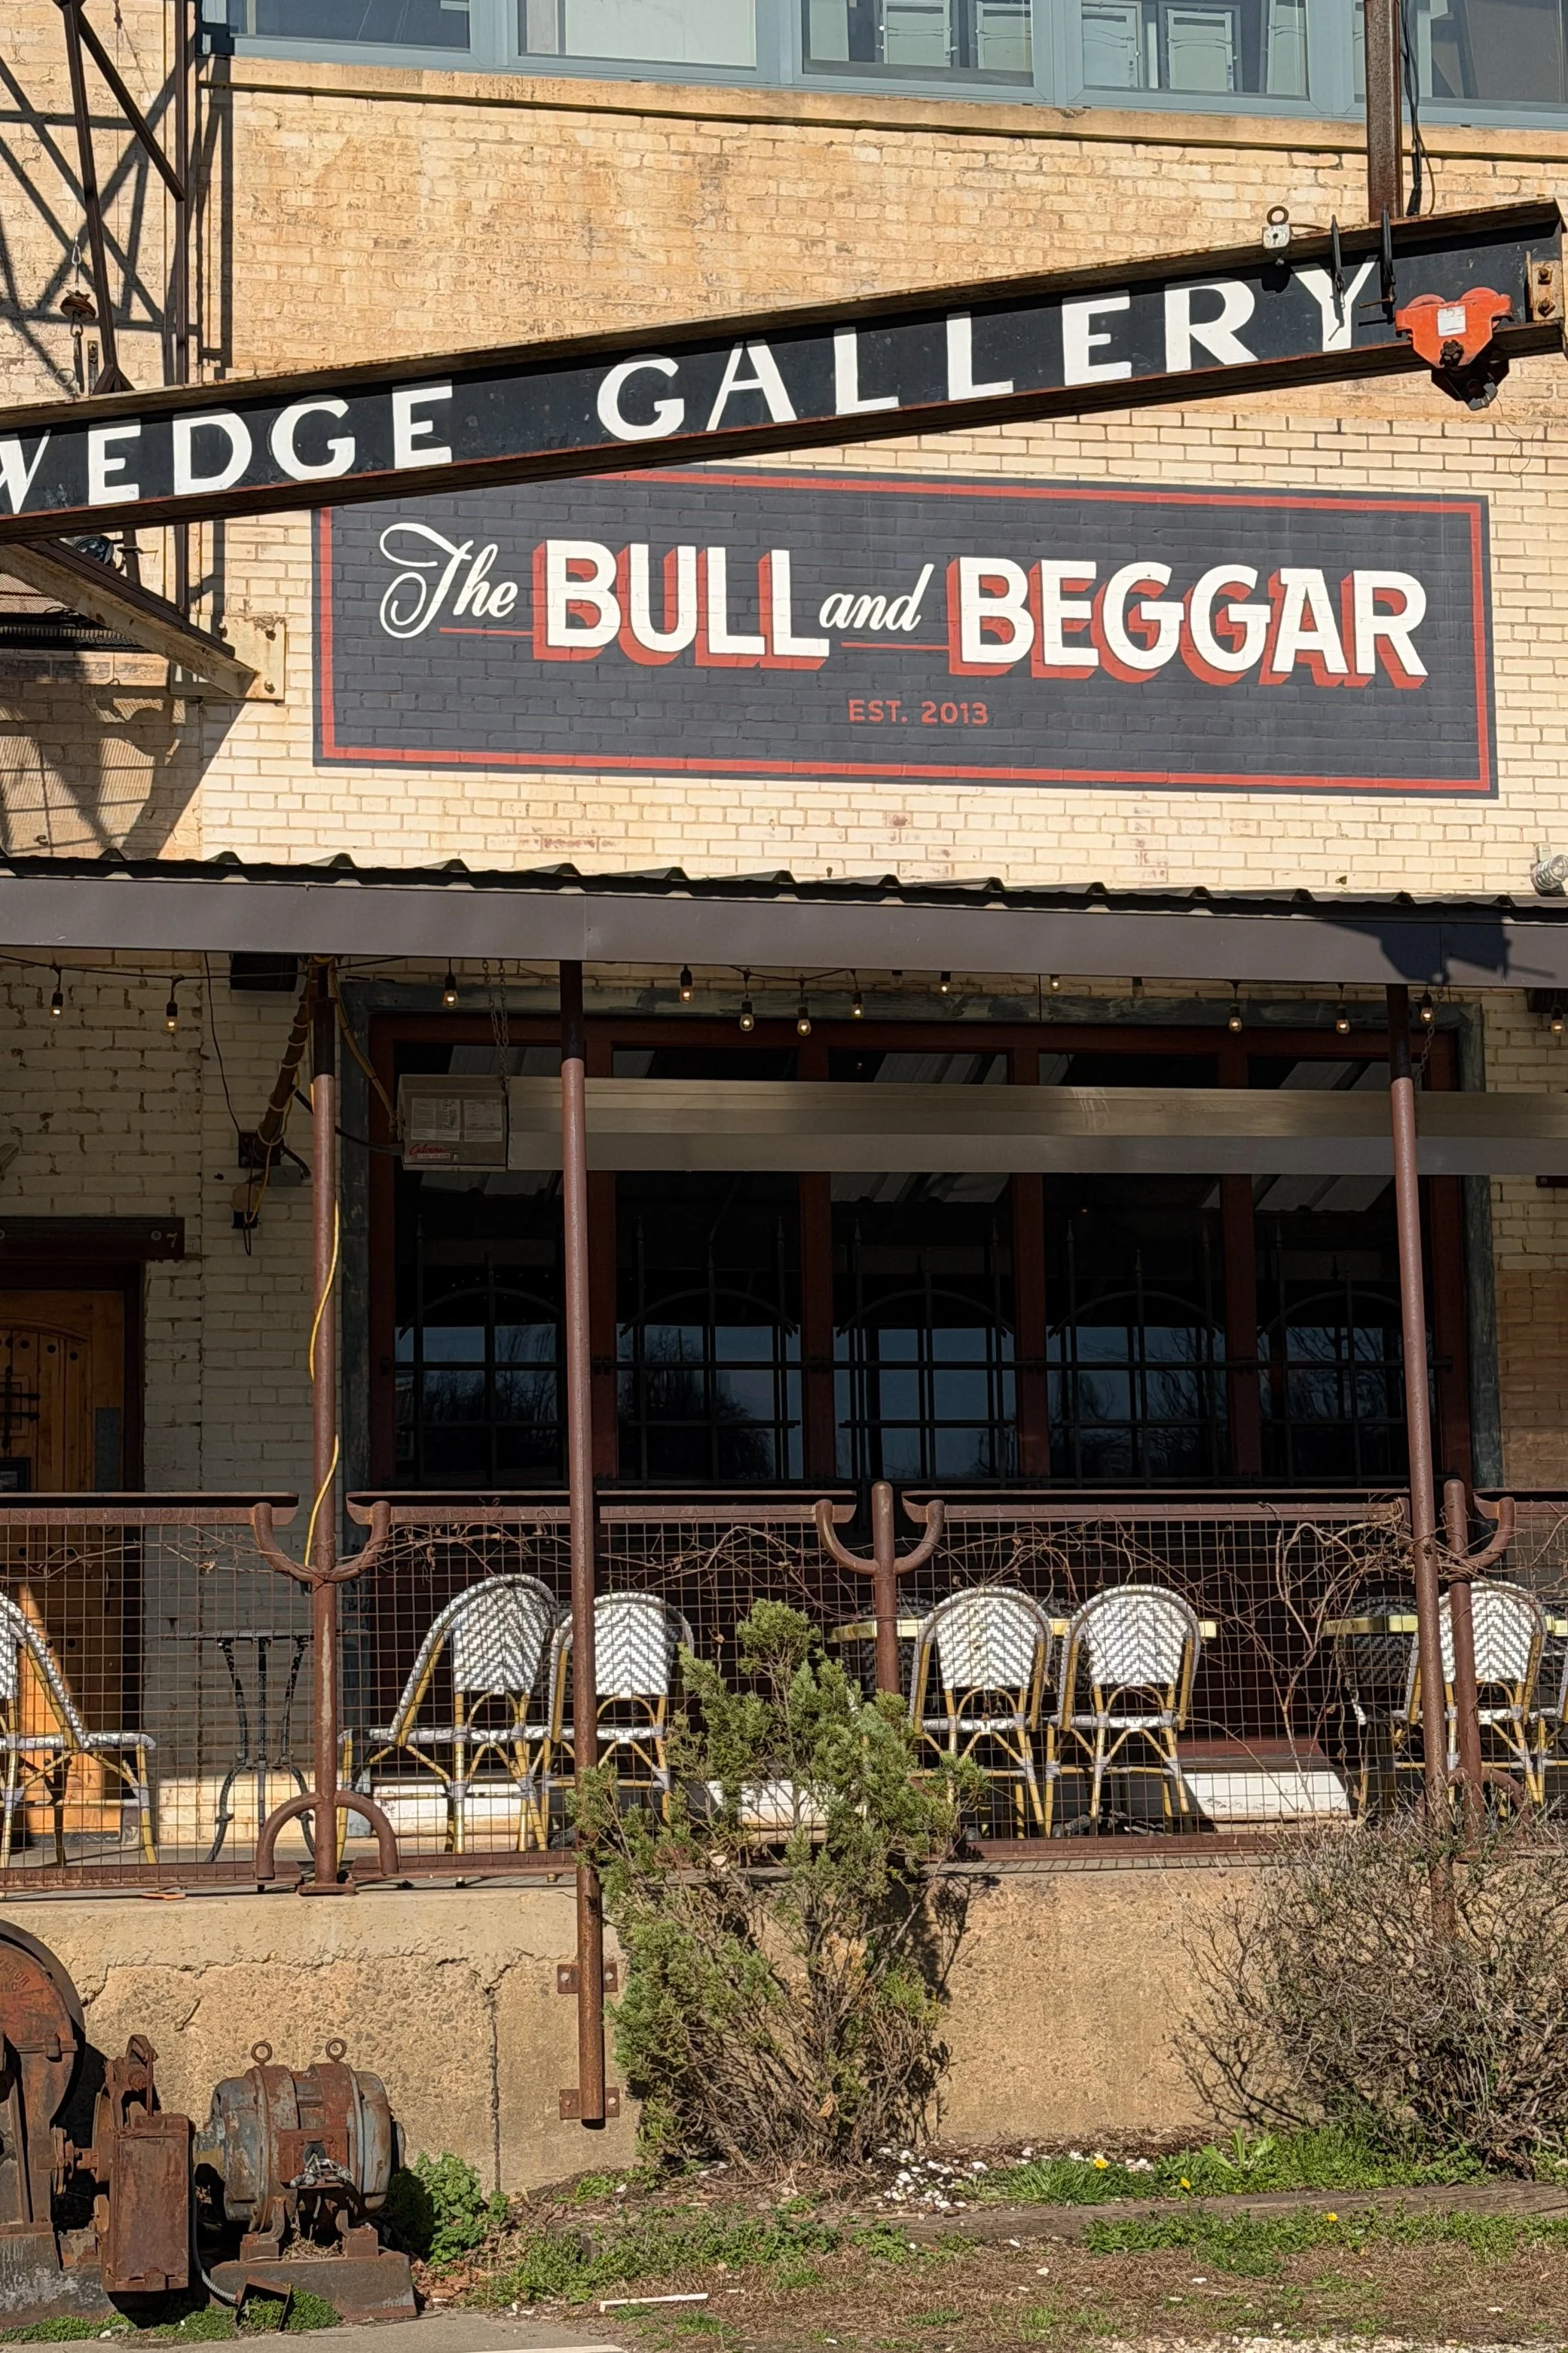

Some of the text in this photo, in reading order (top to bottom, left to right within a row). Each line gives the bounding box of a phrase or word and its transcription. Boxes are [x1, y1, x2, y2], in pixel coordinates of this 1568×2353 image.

[596, 254, 1379, 441] GALLERY
[378, 522, 1429, 689] The BULL and BEGGAR
[848, 699, 989, 725] EST. 2013
